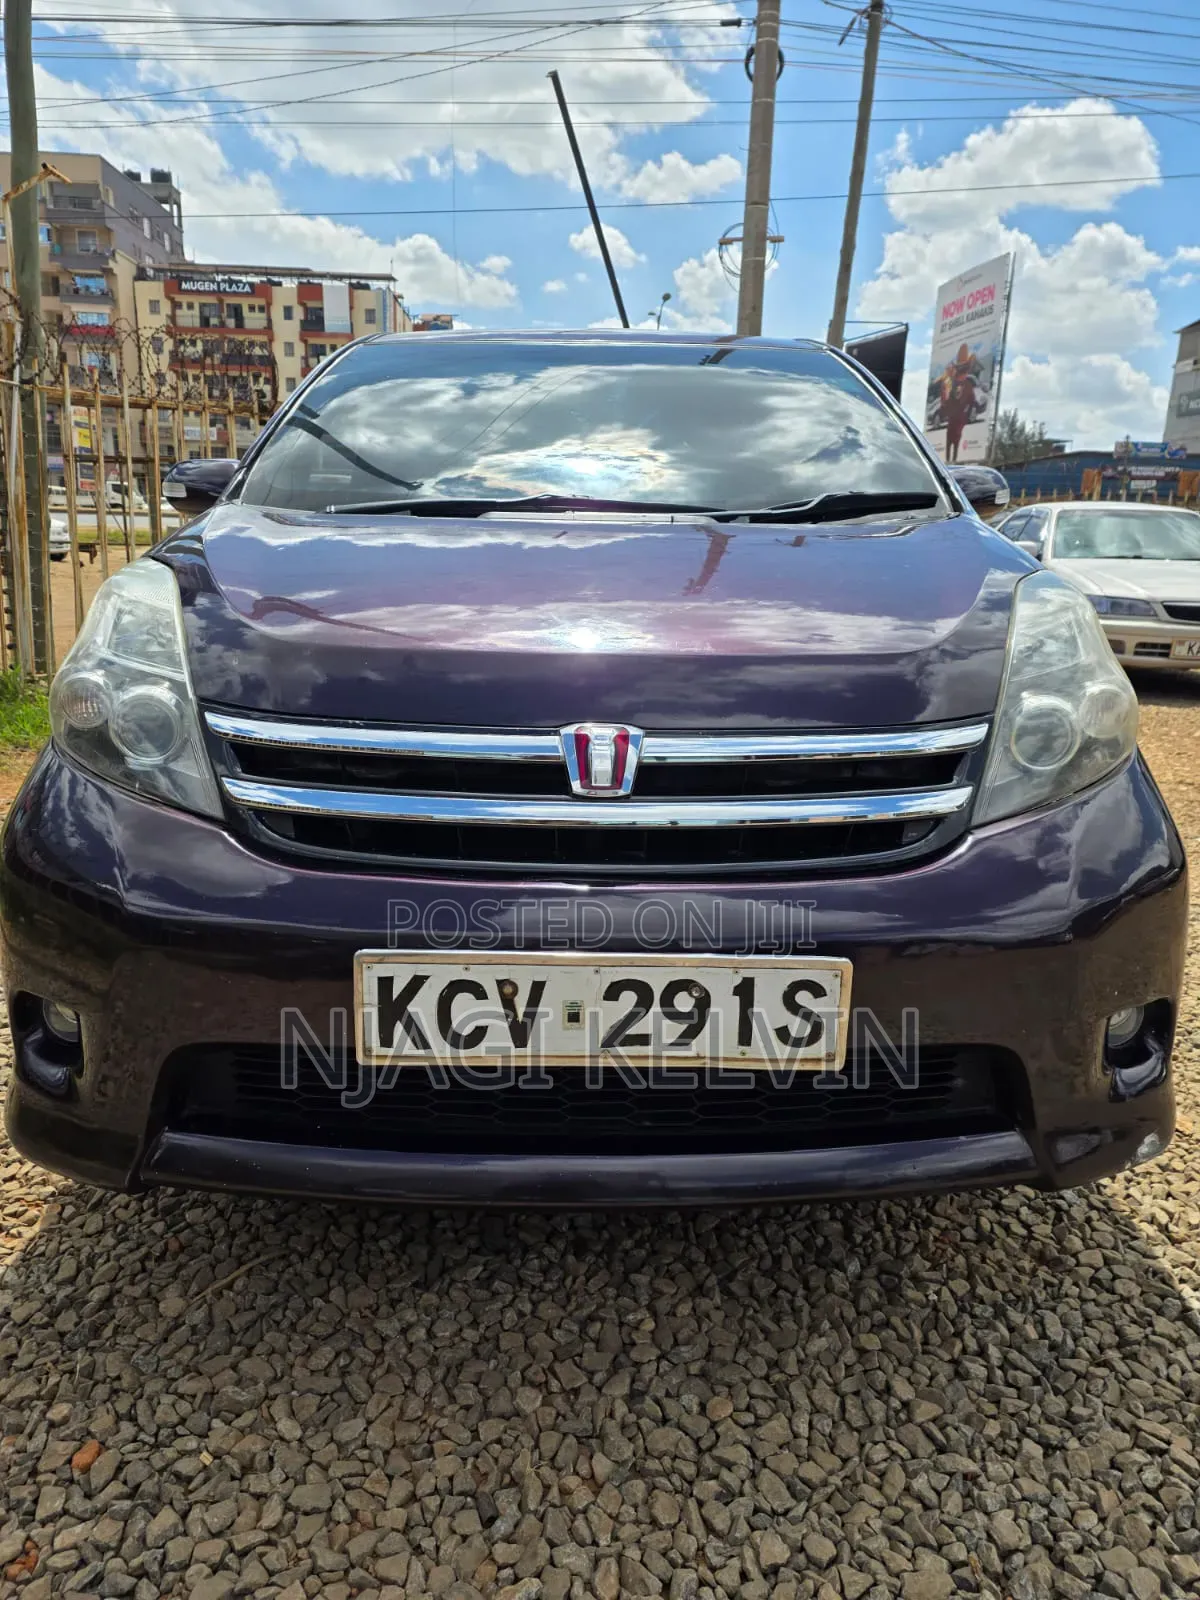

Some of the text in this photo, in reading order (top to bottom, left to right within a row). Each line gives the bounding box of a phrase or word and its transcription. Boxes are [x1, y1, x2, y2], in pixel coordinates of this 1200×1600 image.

[181, 280, 252, 293] MUGEN PLAZA
[942, 282, 996, 321] NOW OPEN
[376, 974, 828, 1050] KCV 291S
